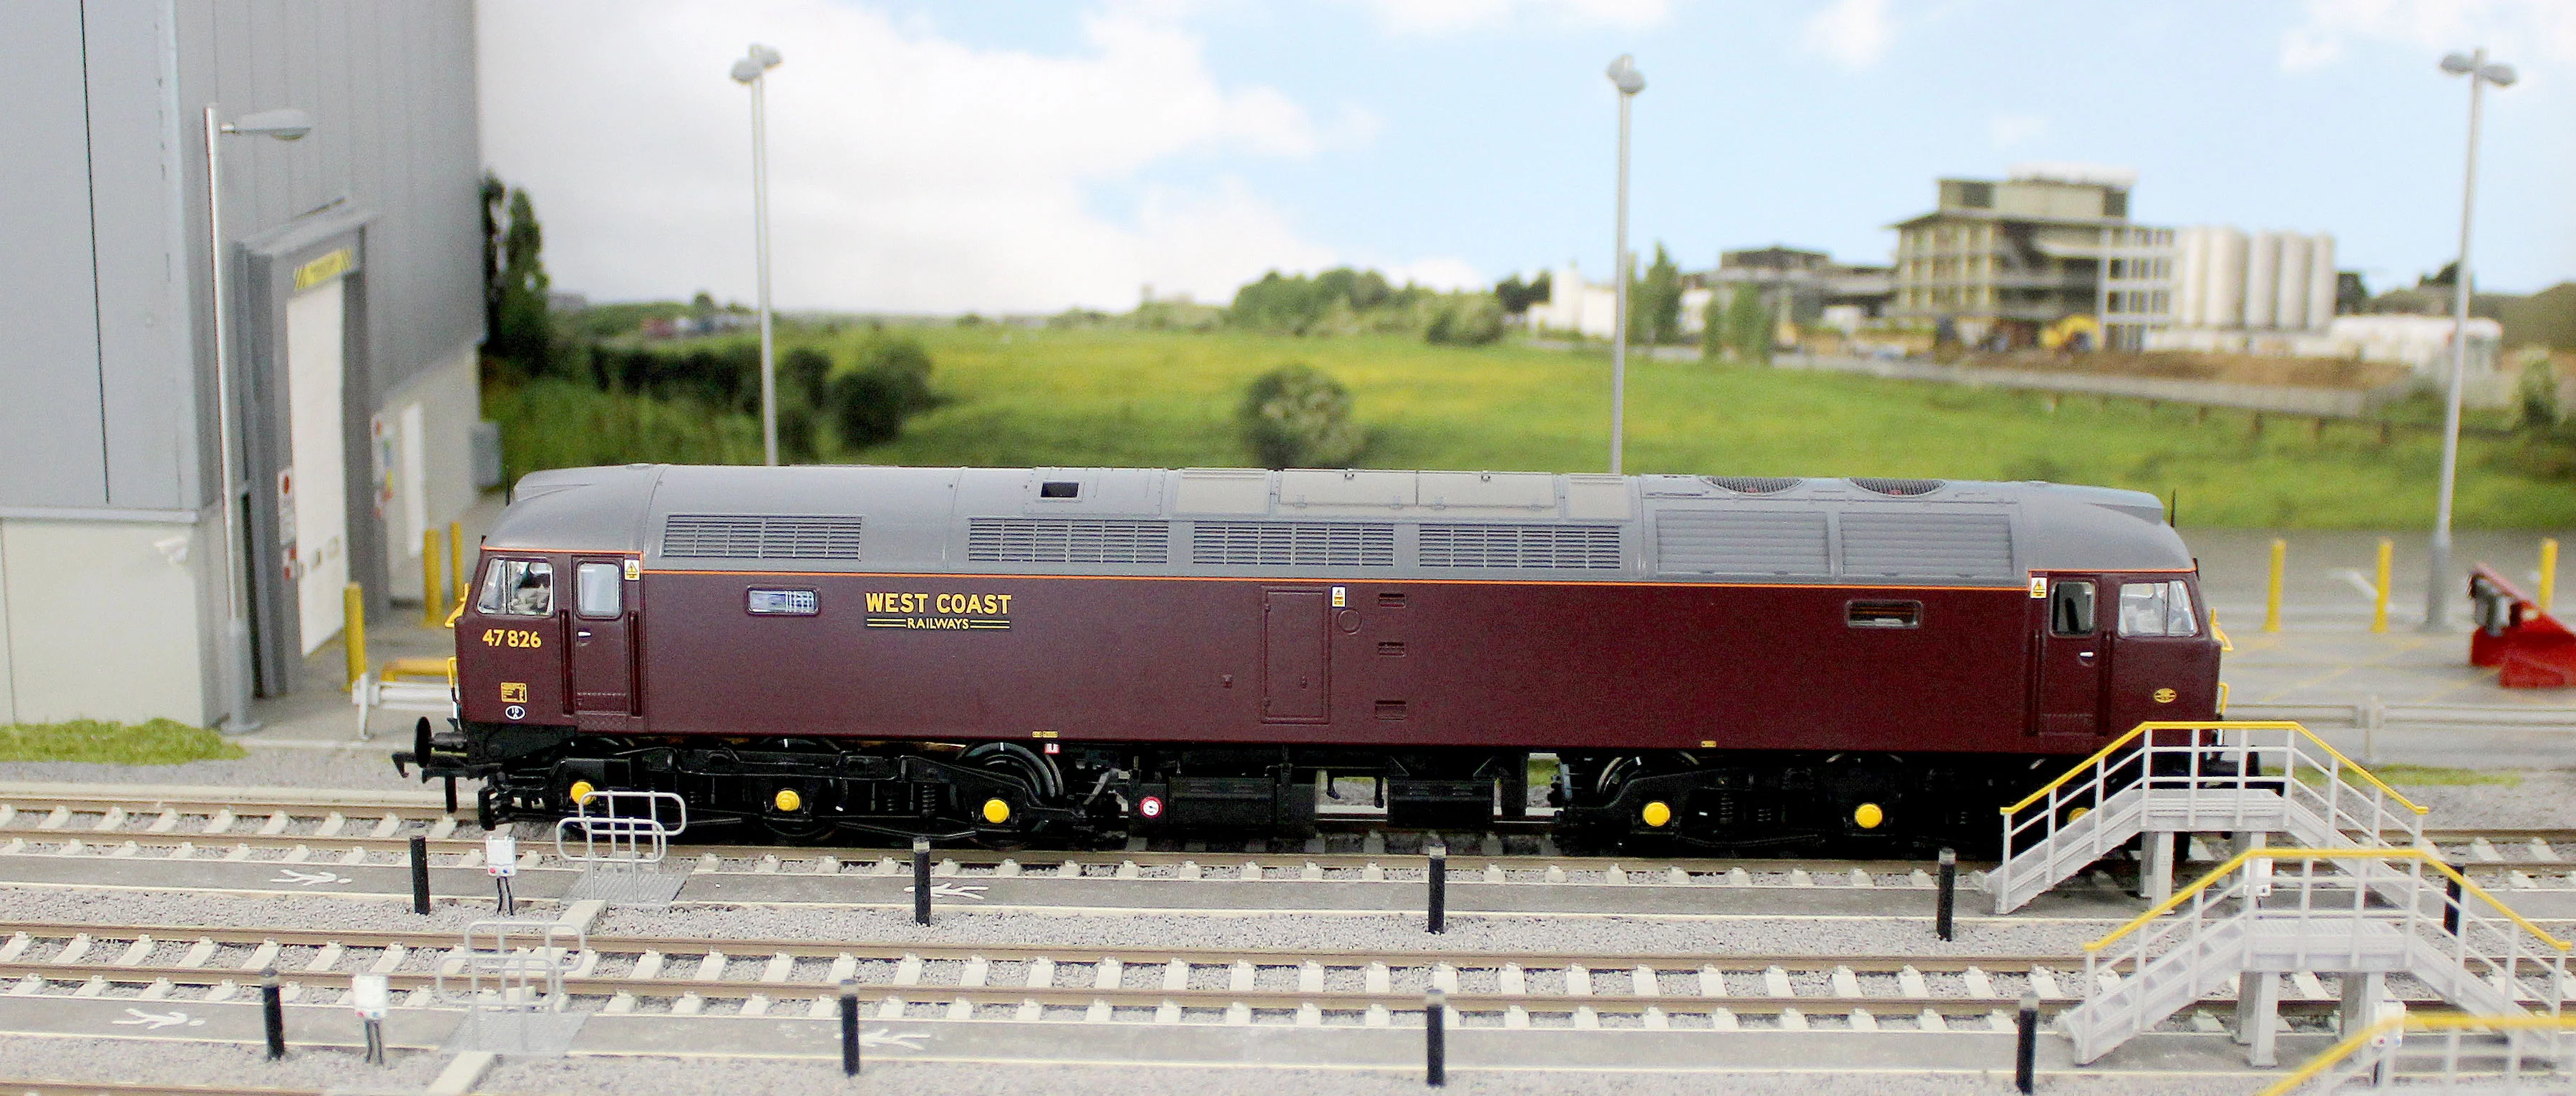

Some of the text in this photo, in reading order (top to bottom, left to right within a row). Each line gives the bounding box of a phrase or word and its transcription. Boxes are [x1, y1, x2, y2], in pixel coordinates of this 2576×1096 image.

[865, 591, 1013, 615] WEST COAST
[906, 617, 970, 630] RAILWAYS
[482, 629, 542, 649] 47 826
